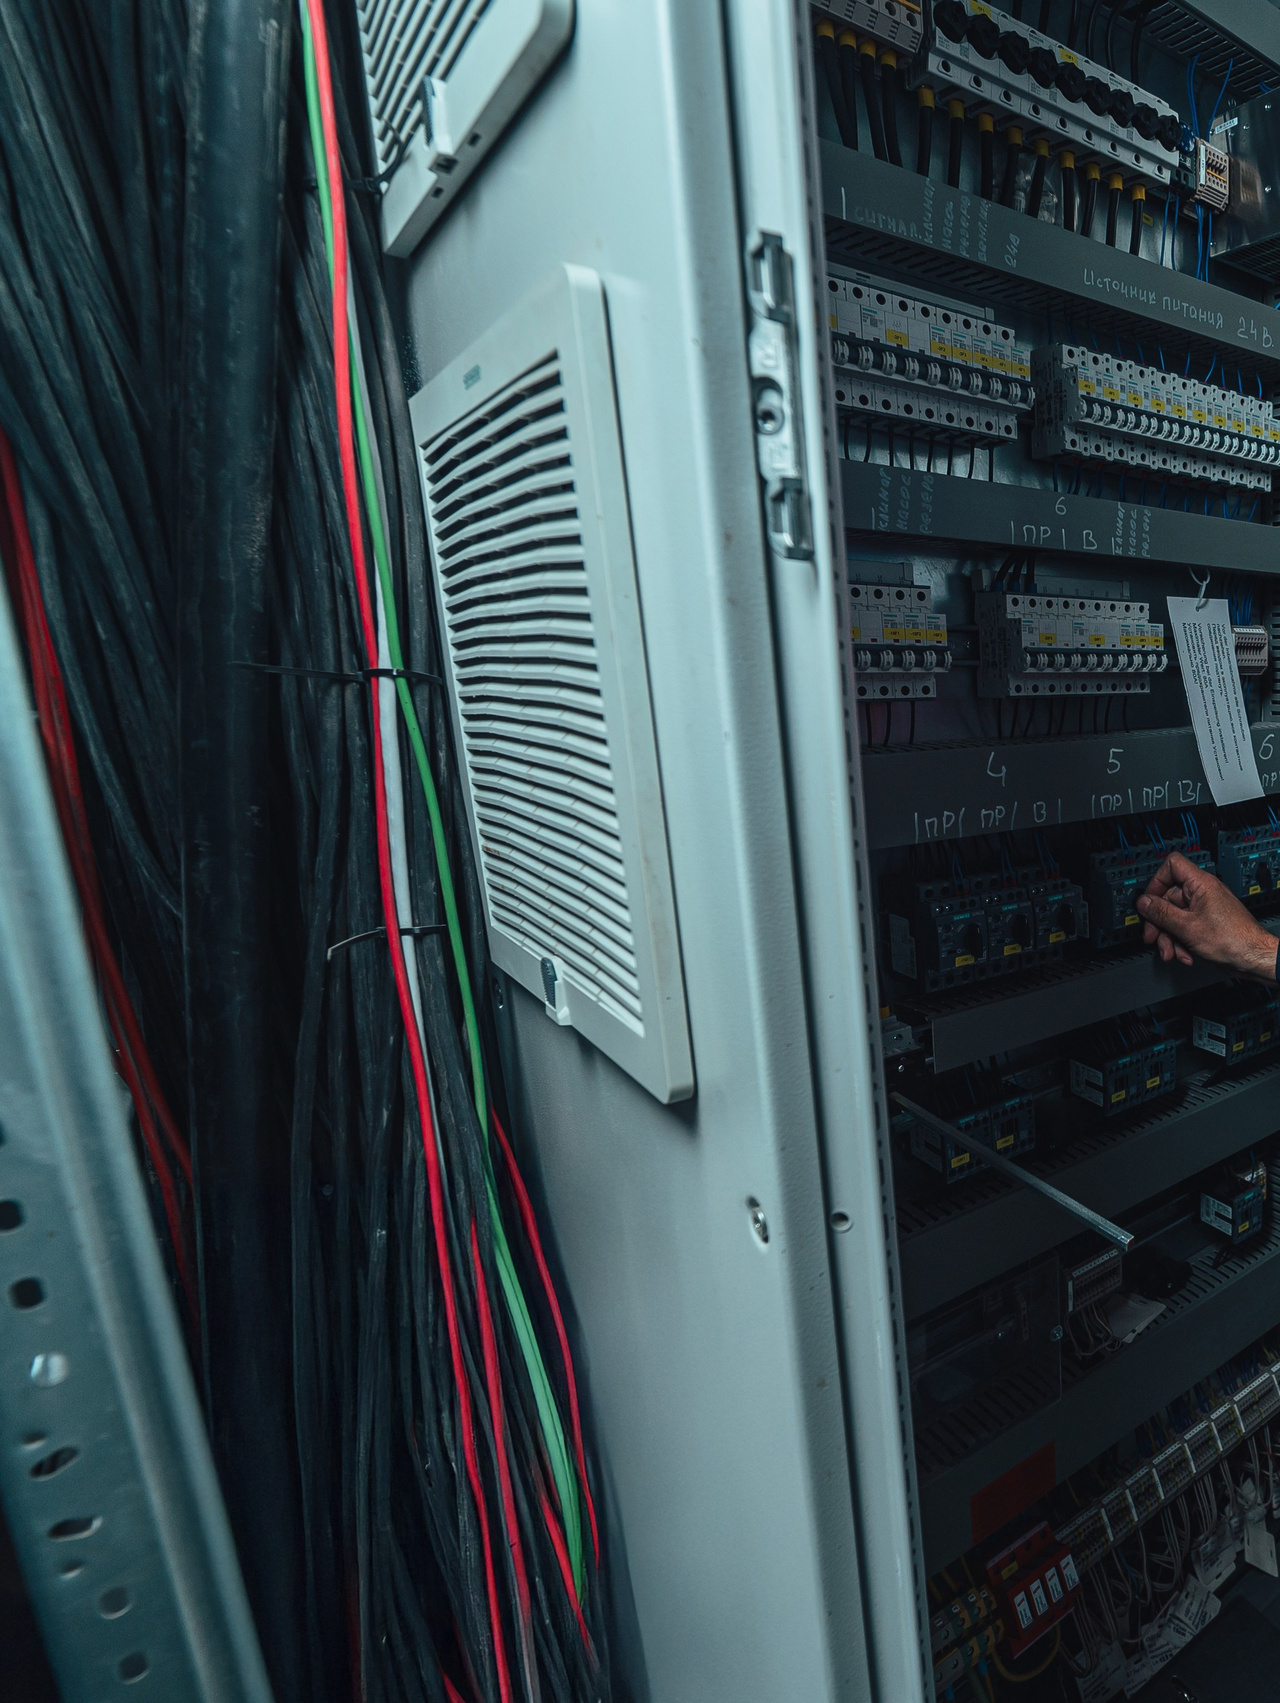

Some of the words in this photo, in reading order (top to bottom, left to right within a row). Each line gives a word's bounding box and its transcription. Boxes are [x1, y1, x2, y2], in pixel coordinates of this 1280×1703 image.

[1162, 296, 1224, 329] питания
[1054, 497, 1067, 515] 6
[1259, 733, 1274, 760] 6
[987, 752, 1006, 787] 4
[1107, 749, 1123, 774] 5
